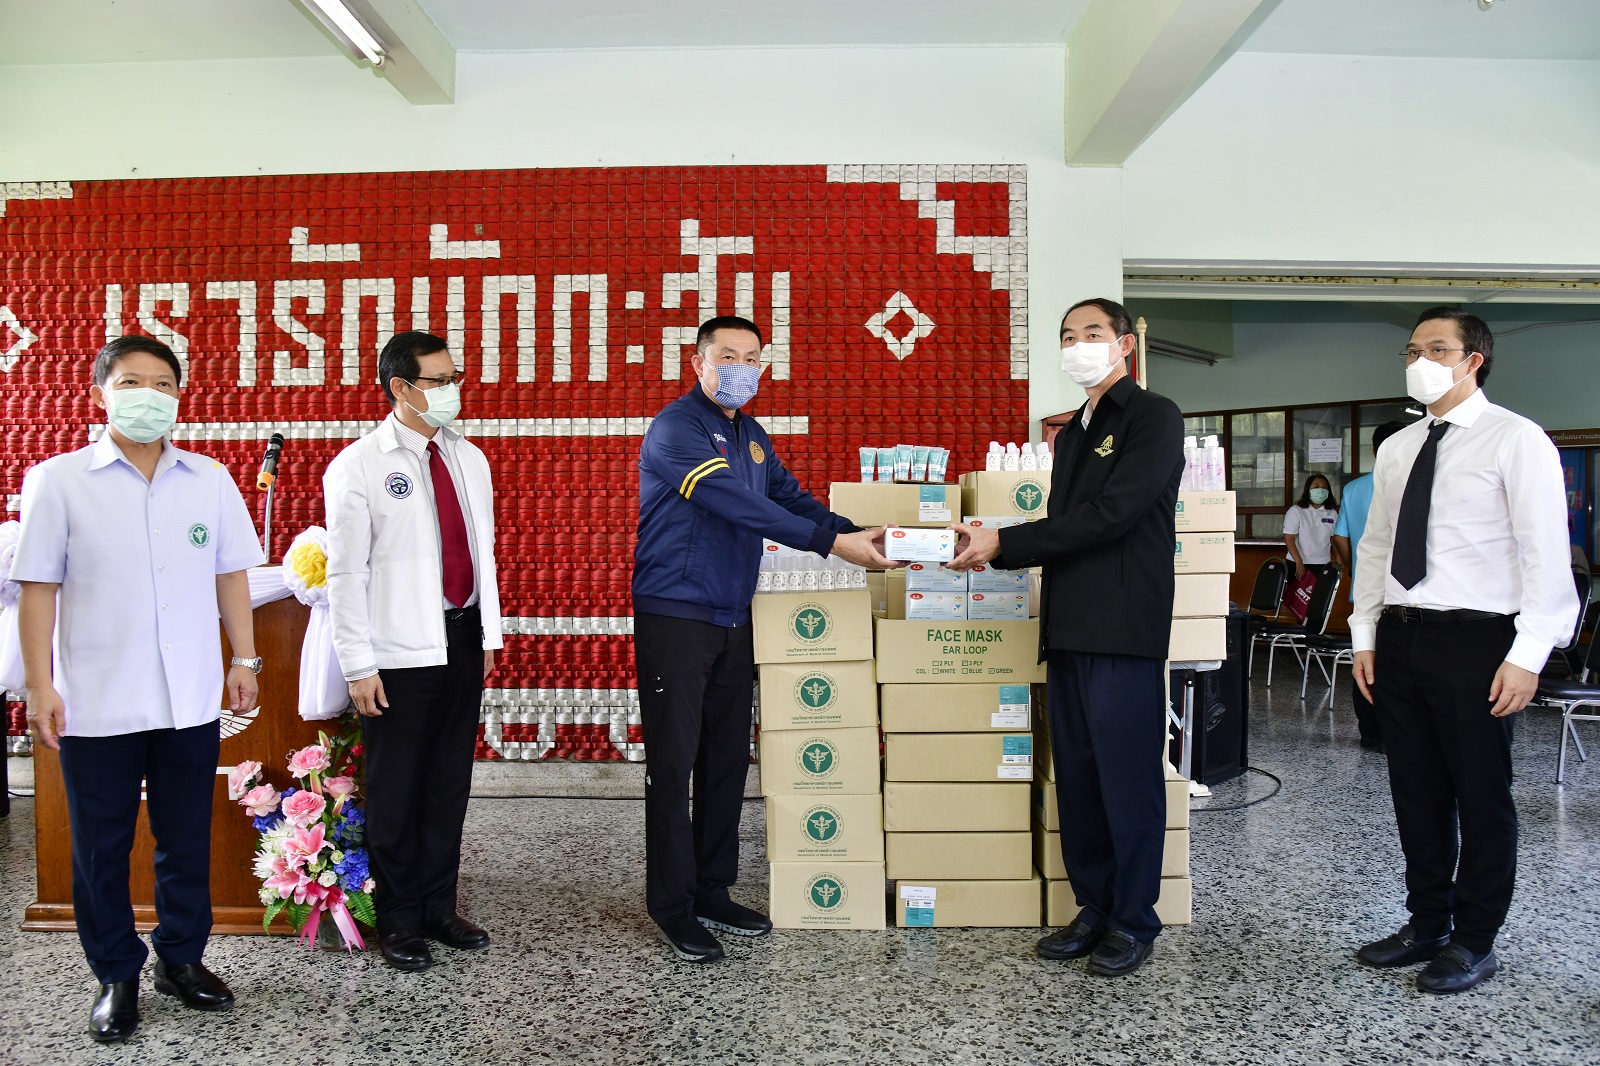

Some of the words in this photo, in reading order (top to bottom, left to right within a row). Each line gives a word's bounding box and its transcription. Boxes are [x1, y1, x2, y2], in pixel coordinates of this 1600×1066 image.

[927, 629, 961, 642] FACE
[965, 629, 1003, 642] MASK
[943, 645, 961, 654] EAR
[963, 645, 988, 654] LOOP
